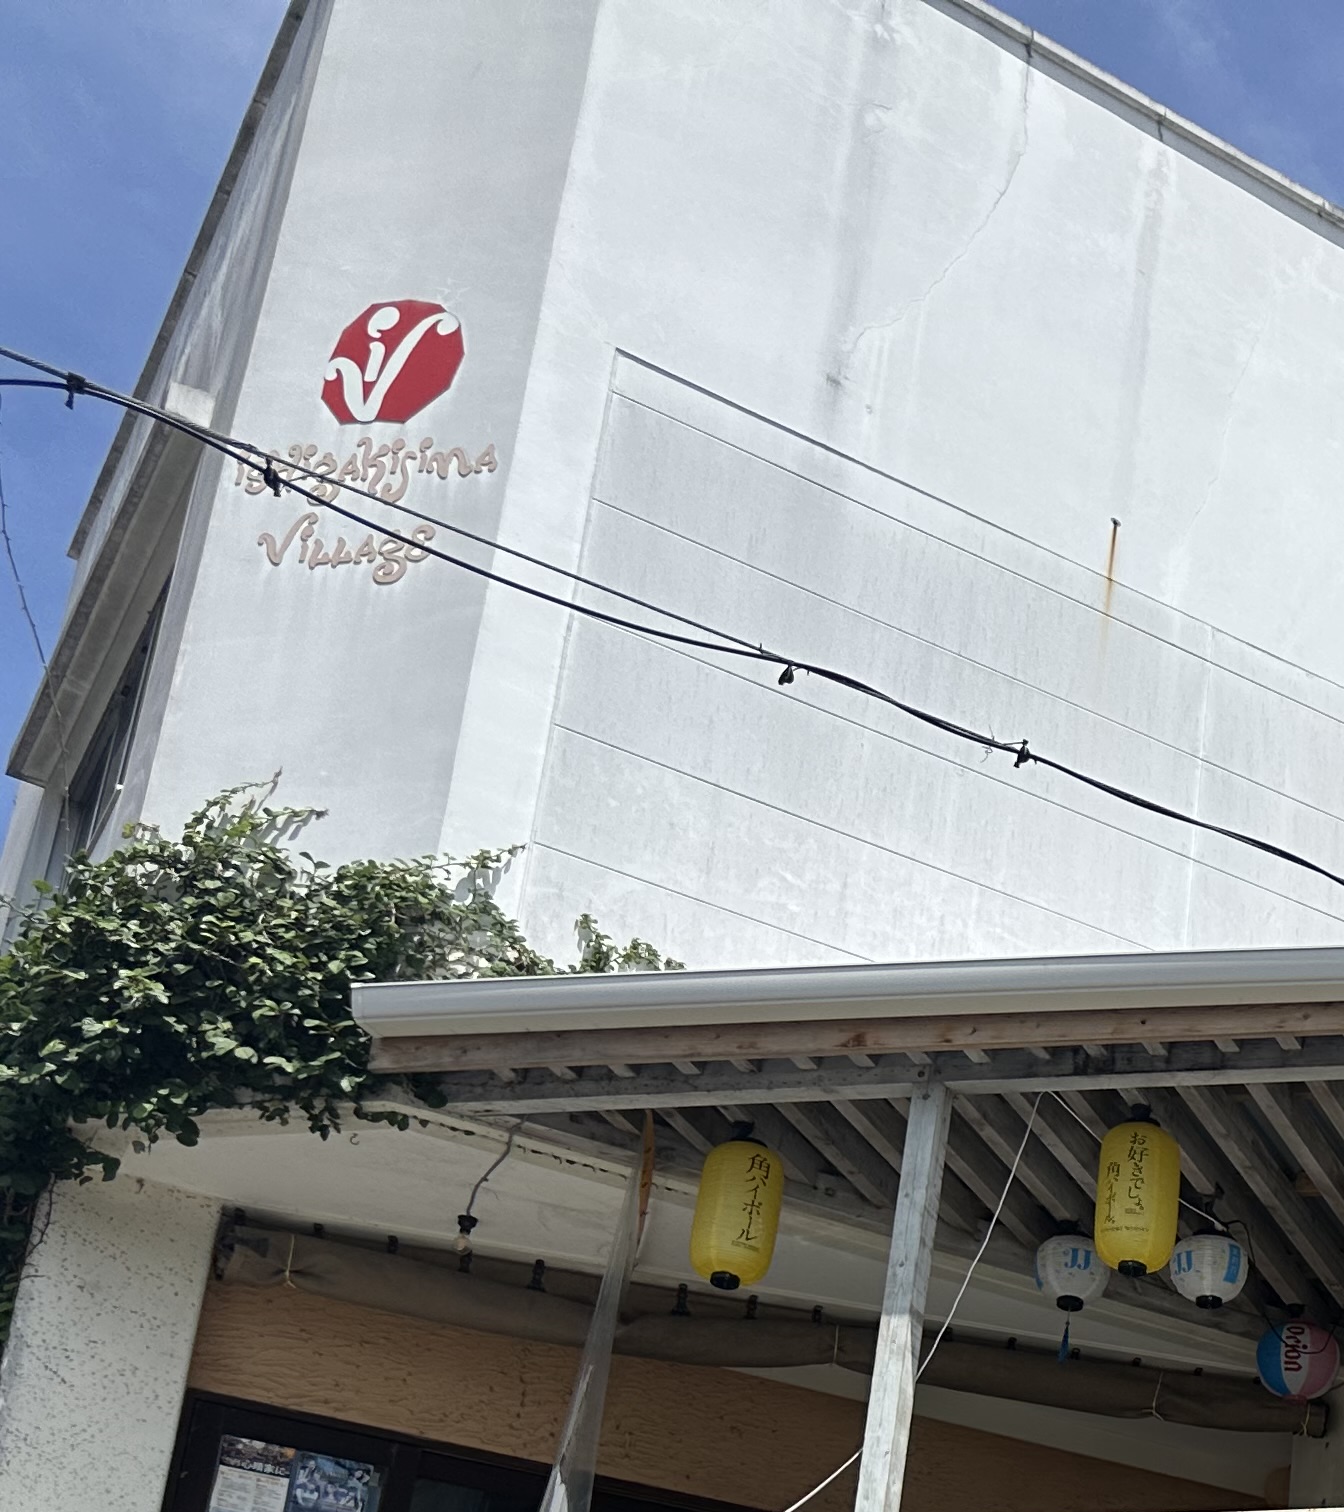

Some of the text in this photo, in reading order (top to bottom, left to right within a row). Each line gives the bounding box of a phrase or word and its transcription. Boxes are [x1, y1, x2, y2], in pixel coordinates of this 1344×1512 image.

[736, 1153, 771, 1241] 角ハイボール
